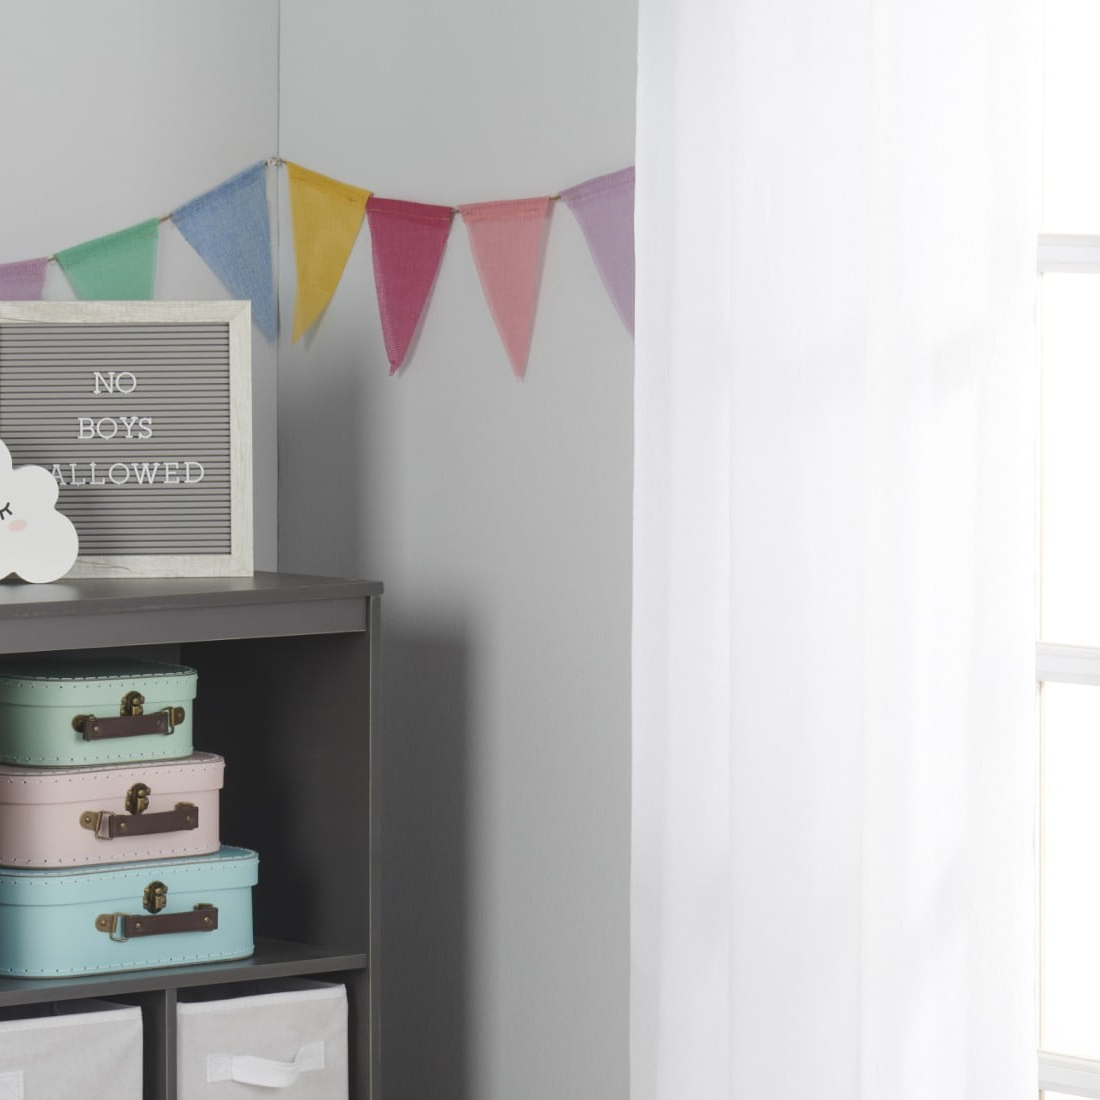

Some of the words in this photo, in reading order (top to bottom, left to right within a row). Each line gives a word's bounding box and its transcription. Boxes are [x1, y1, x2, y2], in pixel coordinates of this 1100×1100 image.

[93, 371, 137, 395] NO
[77, 416, 153, 440] BOYS
[51, 461, 205, 487] ALLOWED
